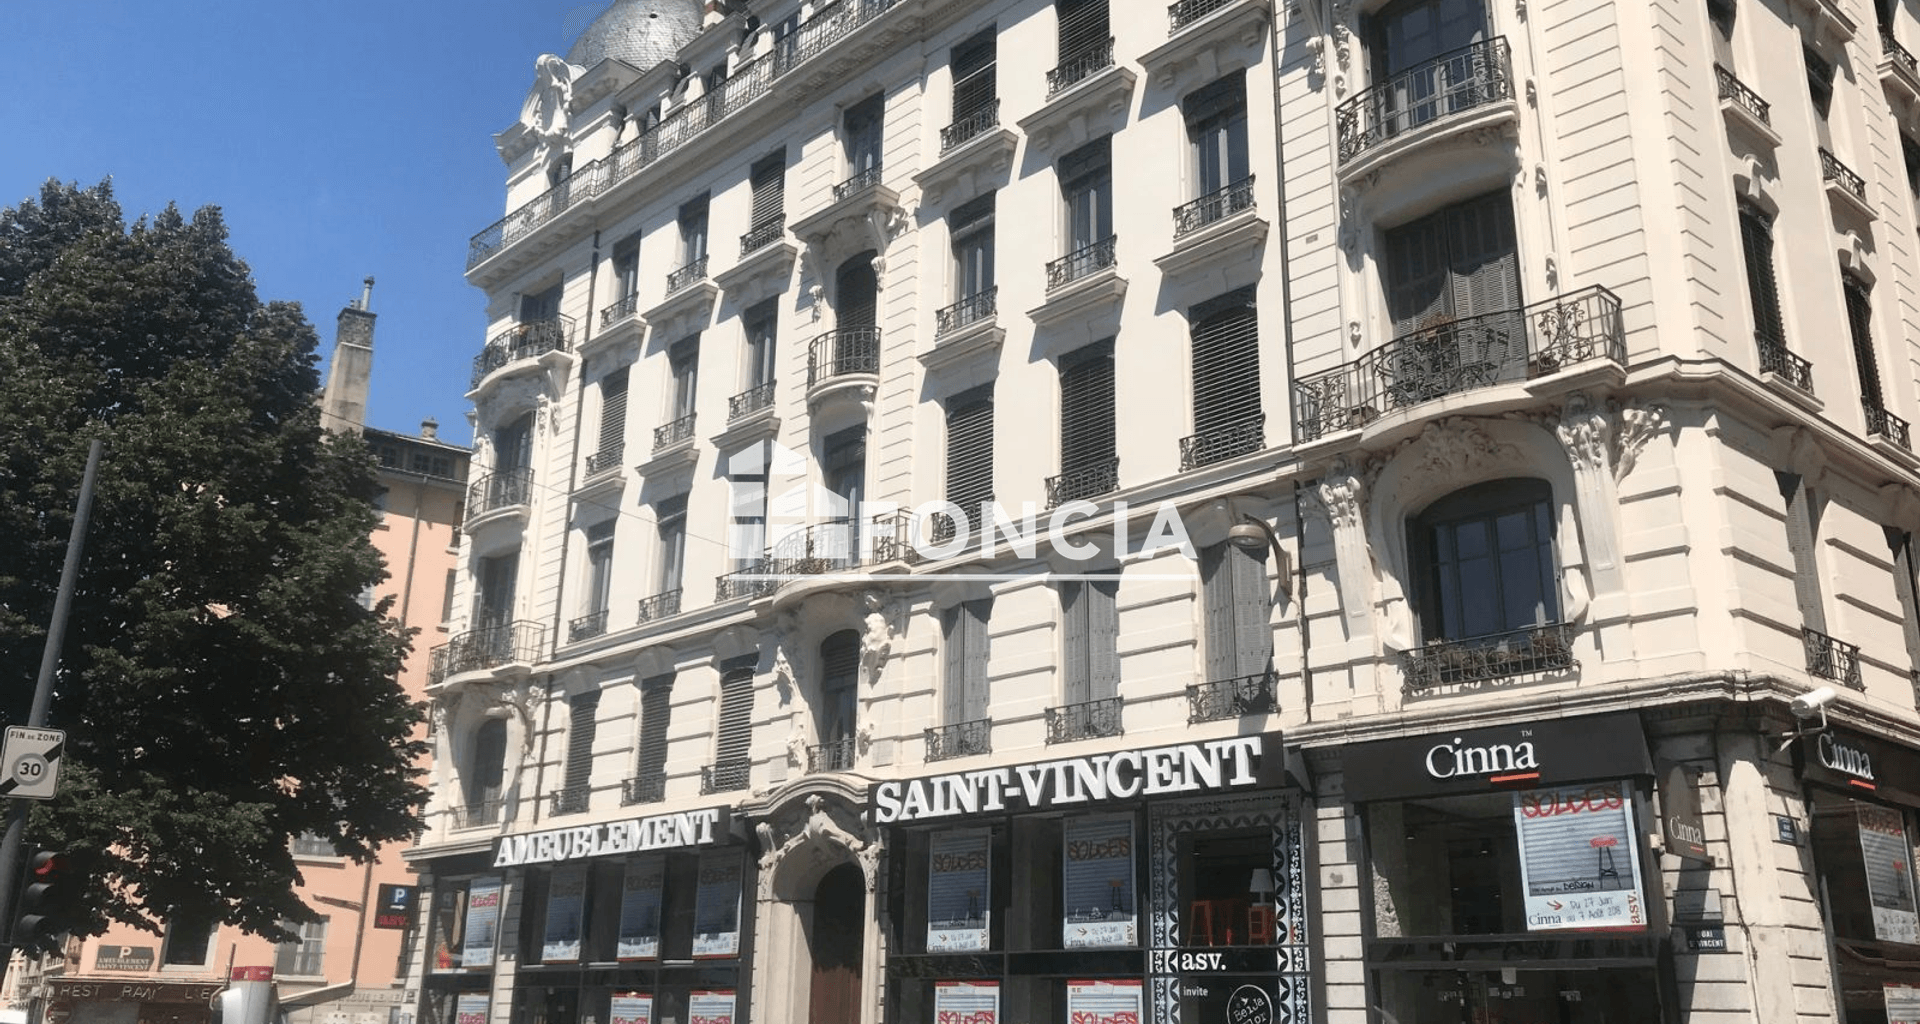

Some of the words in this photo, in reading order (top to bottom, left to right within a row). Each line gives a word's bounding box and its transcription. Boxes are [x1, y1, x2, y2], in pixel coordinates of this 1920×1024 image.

[10, 731, 25, 739] FIN
[38, 733, 61, 742] ZONE
[1425, 737, 1540, 778] Cinna
[1818, 731, 1874, 780] Cinna
[20, 762, 41, 776] 30
[876, 736, 1262, 823] SAINT-VINCENT
[493, 808, 719, 867] AMEUBLEMENT
[1670, 815, 1703, 845] Cinna
[394, 888, 406, 902] P
[1528, 912, 1563, 925] Cinna
[119, 947, 132, 958] P
[1181, 953, 1227, 971] asv.
[1183, 986, 1209, 997] invite
